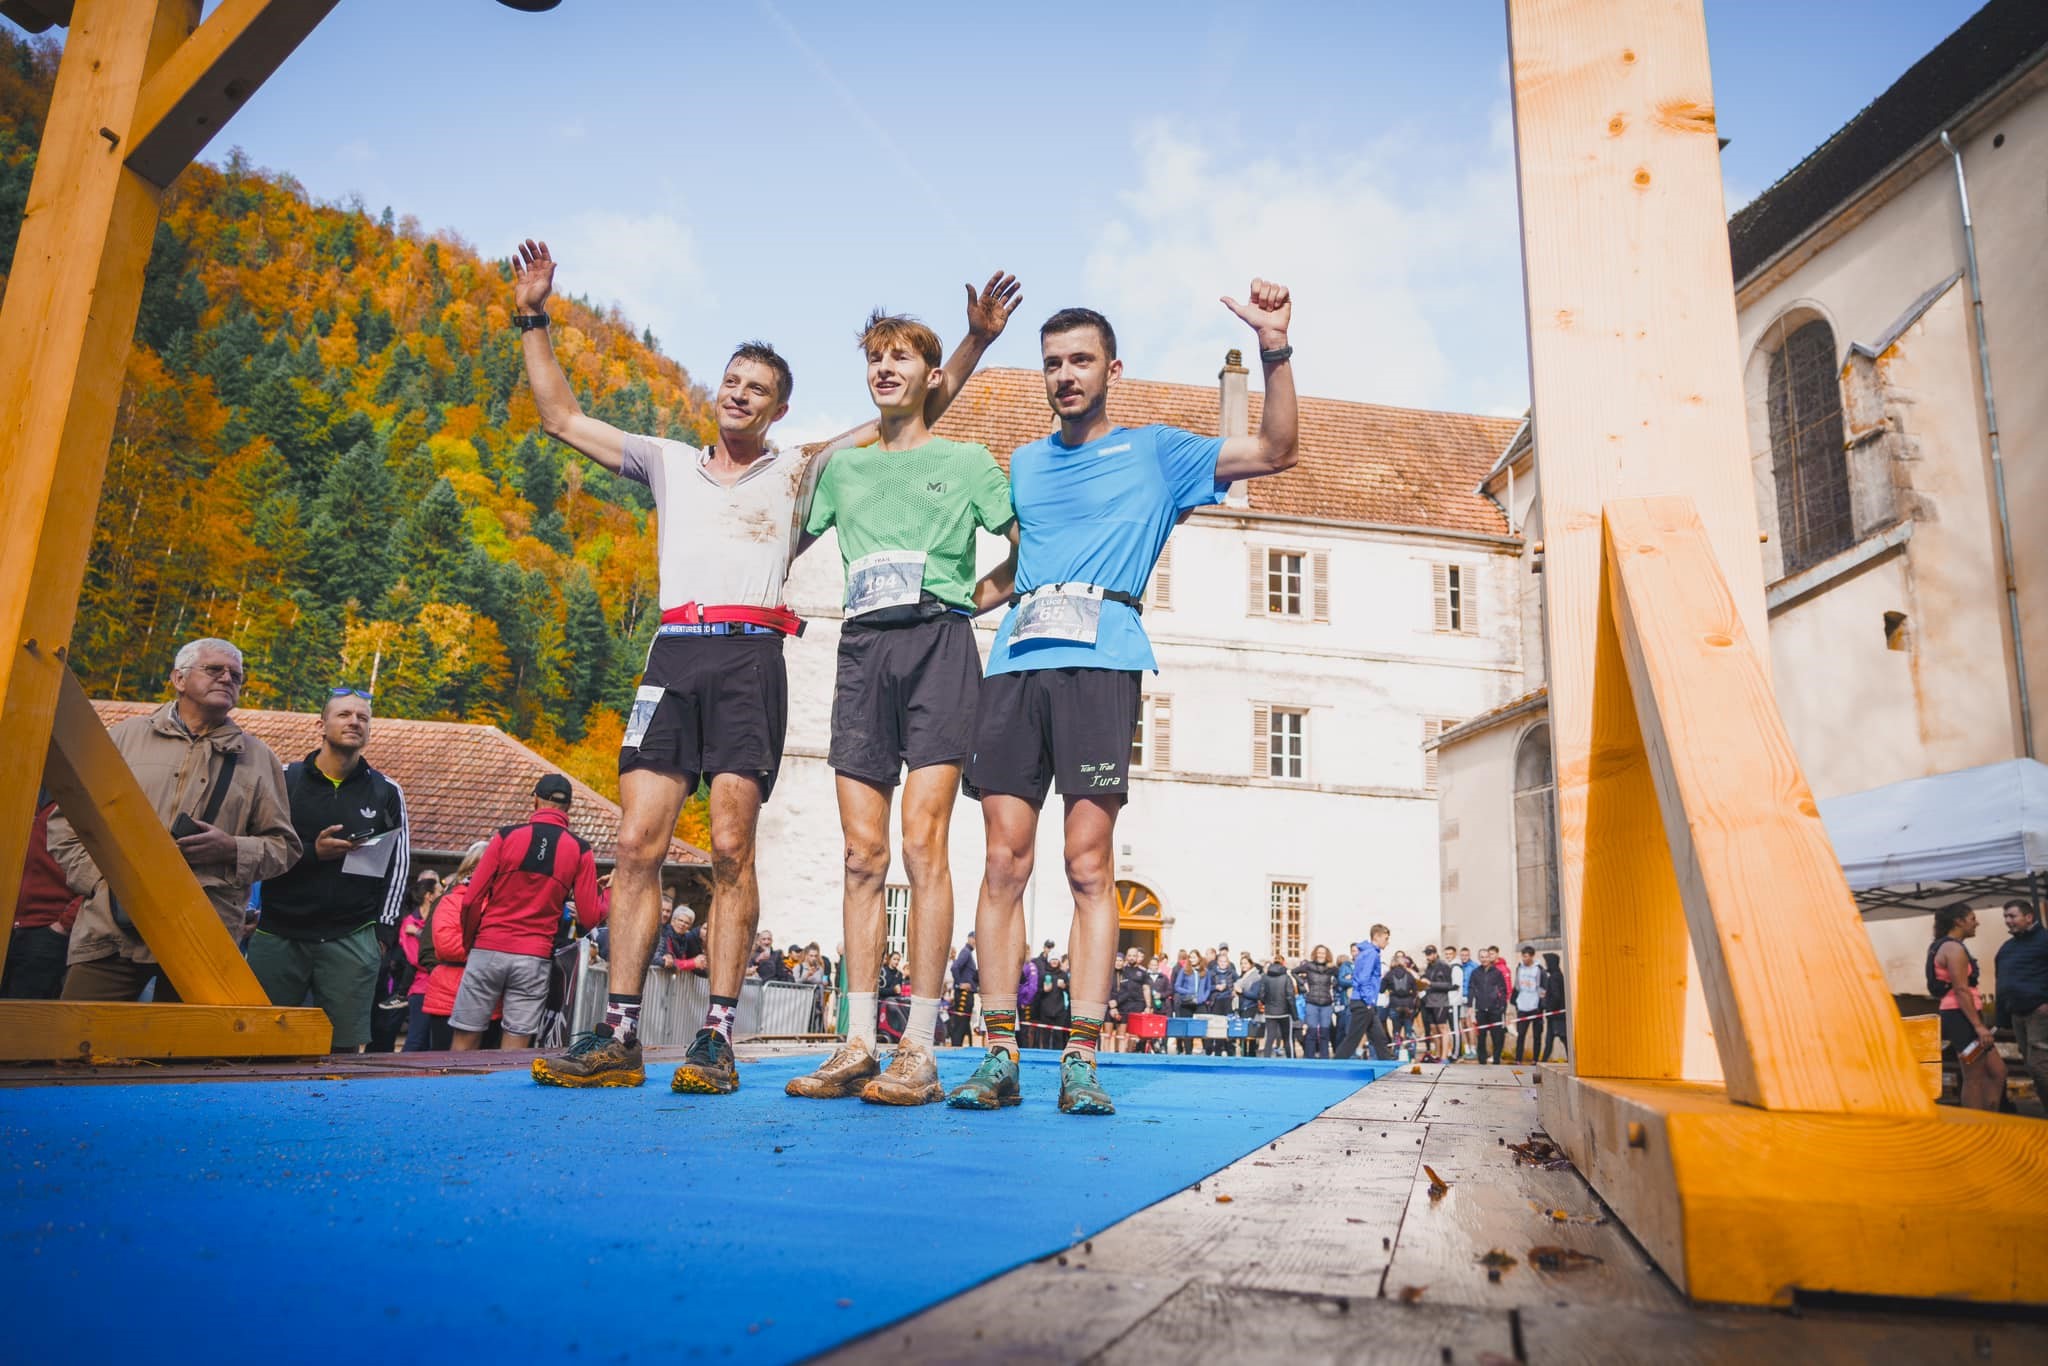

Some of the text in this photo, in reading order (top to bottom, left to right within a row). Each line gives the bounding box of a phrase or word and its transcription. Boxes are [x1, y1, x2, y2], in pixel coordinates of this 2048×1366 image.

[866, 574, 898, 594] 194
[1039, 606, 1065, 621] 65
[1098, 762, 1116, 772] Trail
[1089, 775, 1121, 787] Jura
